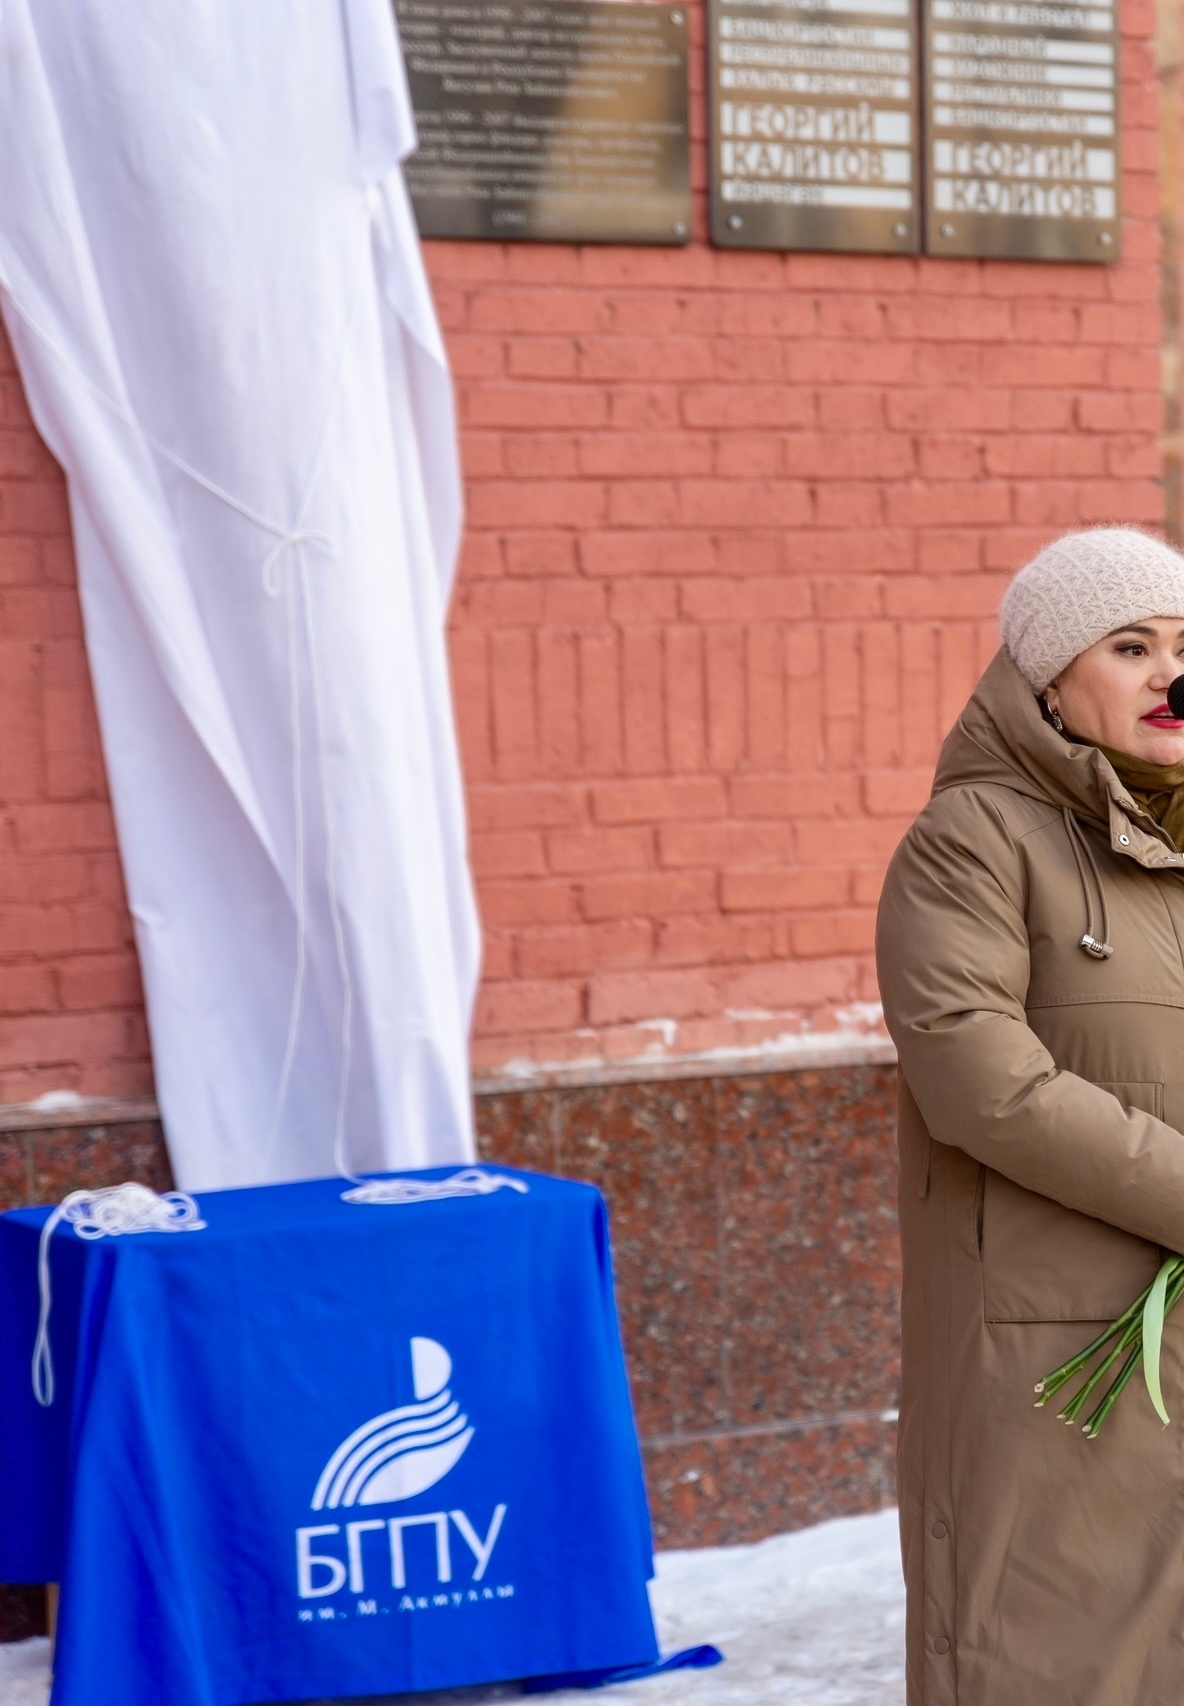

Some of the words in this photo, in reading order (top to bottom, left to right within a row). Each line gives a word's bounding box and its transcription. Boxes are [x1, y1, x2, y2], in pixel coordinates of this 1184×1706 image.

[732, 101, 874, 142] ГЕОРГИЙ
[732, 141, 883, 182] КАЛИТОВ
[952, 140, 1086, 179] ГЕОРГИЙ
[952, 179, 1095, 218] КАЛИТОВ
[296, 1503, 507, 1599] БГПУ
[357, 1598, 390, 1616] М.
